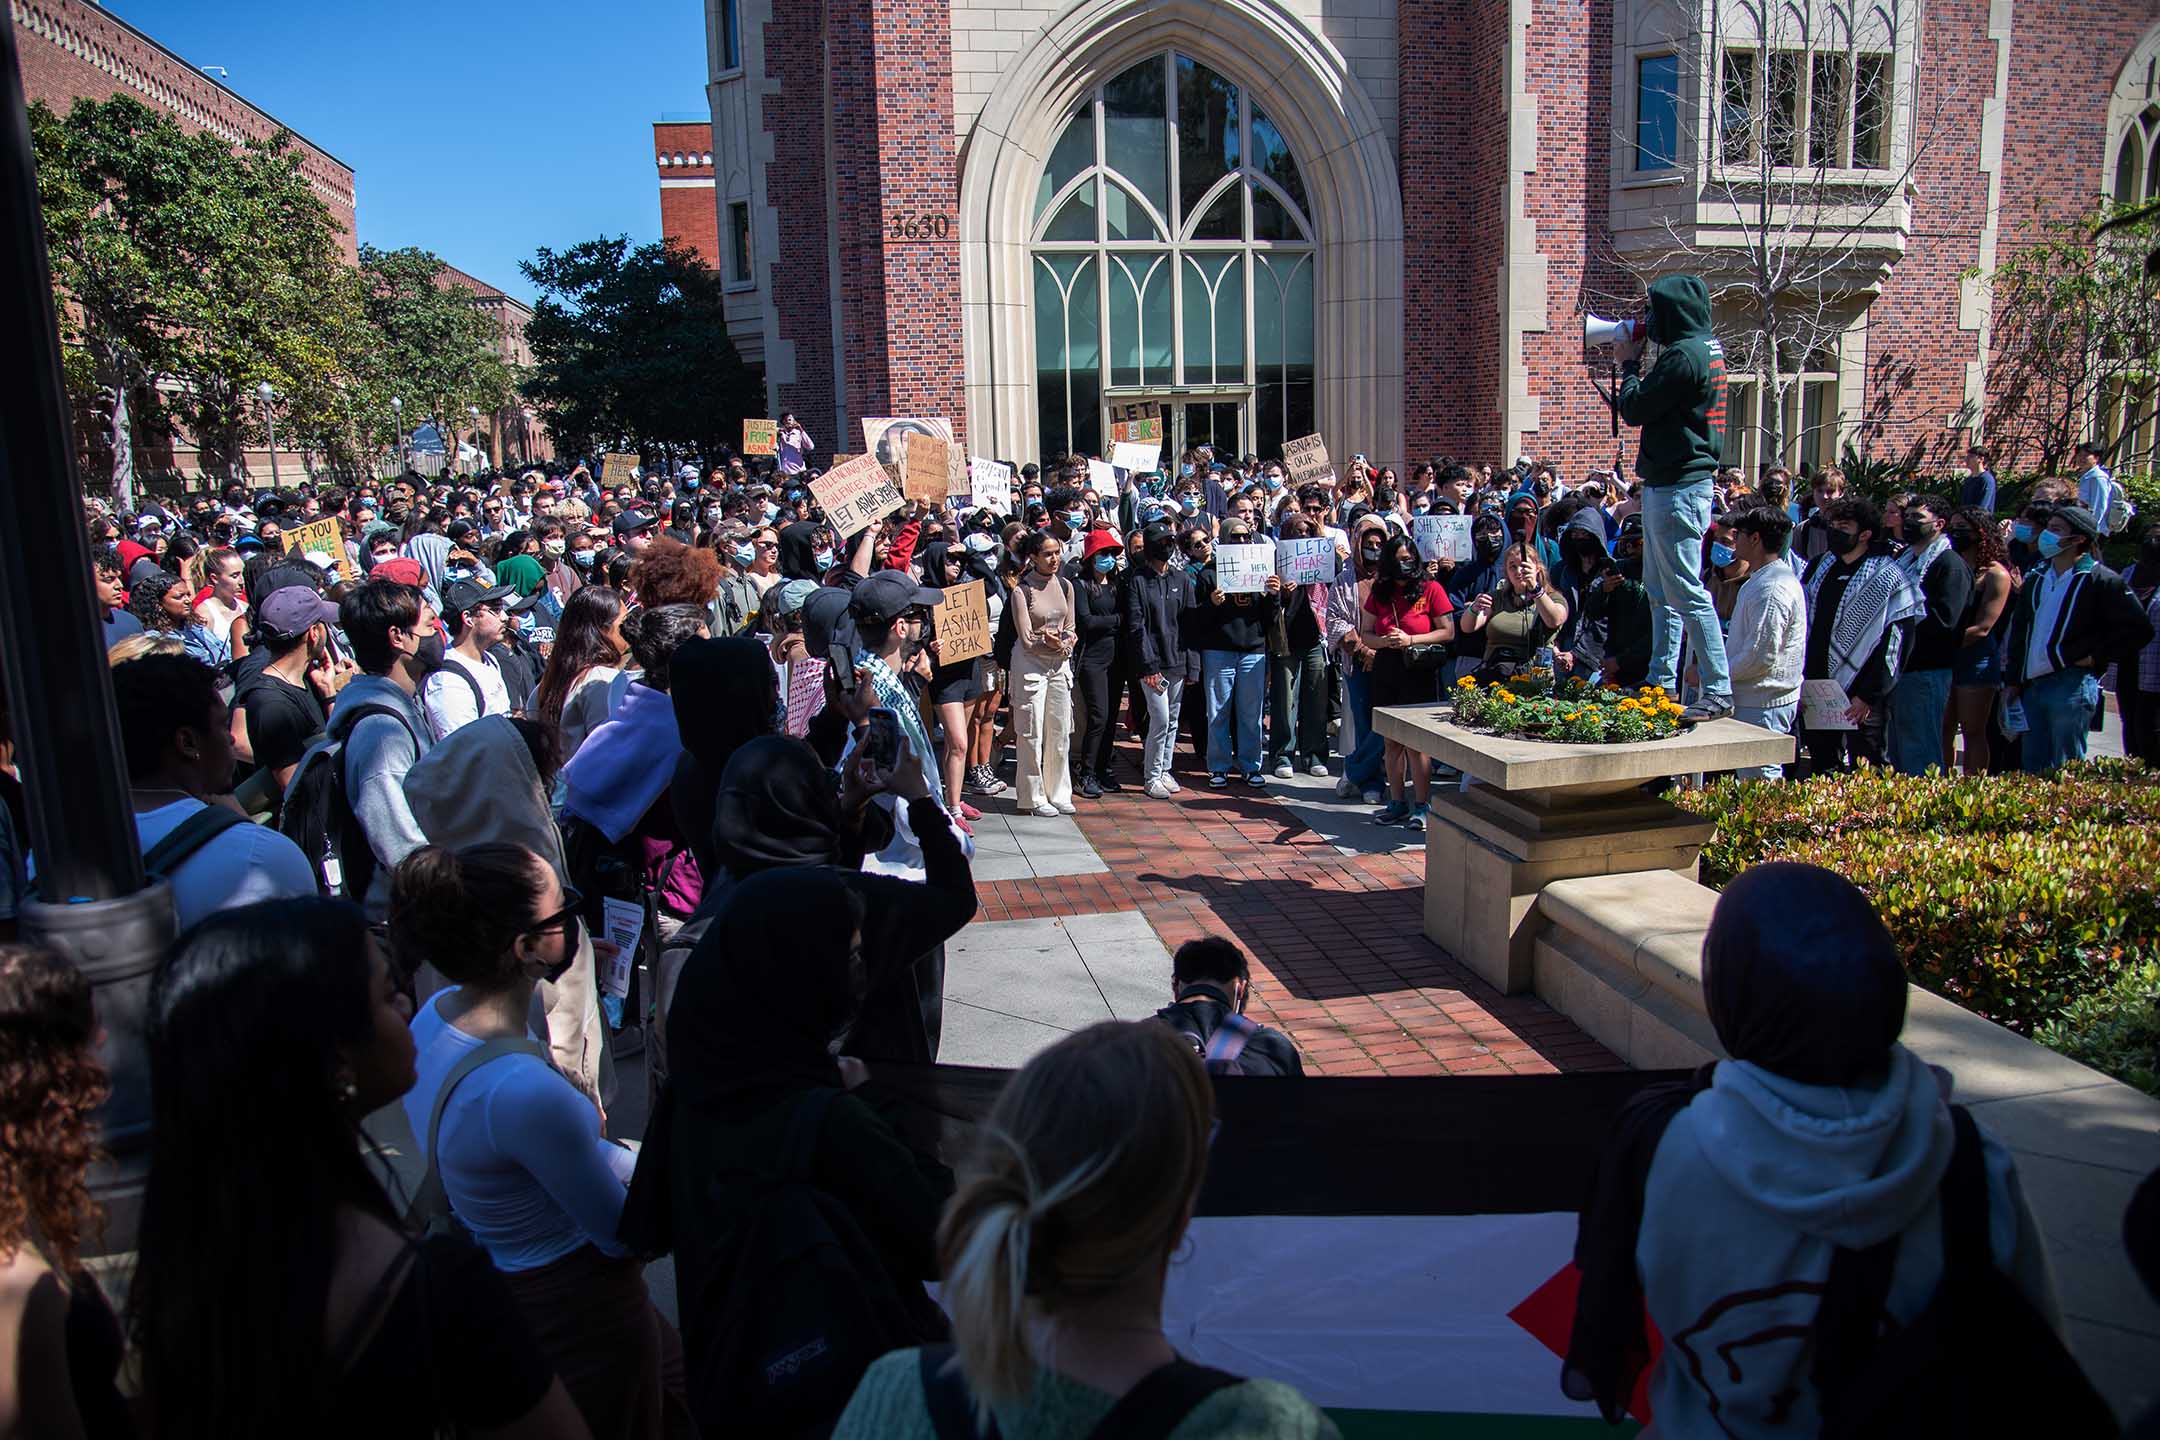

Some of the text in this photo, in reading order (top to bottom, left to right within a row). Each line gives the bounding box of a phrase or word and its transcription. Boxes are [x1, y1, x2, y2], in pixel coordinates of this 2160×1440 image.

[890, 213, 950, 239] 3630
[1112, 401, 1153, 422] LET
[745, 420, 776, 431] JUSTICE
[1114, 419, 1153, 442] HER
[749, 431, 769, 444] FOR
[1286, 435, 1321, 457] ASNA IS
[1294, 453, 1320, 468] OUR
[814, 460, 860, 493] SILENCING
[860, 454, 877, 469] ONE
[822, 479, 868, 508] SILENCES
[866, 473, 877, 486] US
[828, 503, 854, 530] LET
[855, 490, 882, 516] ASNA
[874, 479, 900, 506] SPEAK
[288, 520, 332, 546] IF YOU
[1242, 546, 1264, 560] LET
[1295, 555, 1329, 571] HEAR
[1250, 563, 1268, 573] HER
[1300, 569, 1321, 583] HER
[944, 587, 972, 612] LET
[940, 608, 982, 640] ASNA
[950, 634, 984, 657] SPEAK
